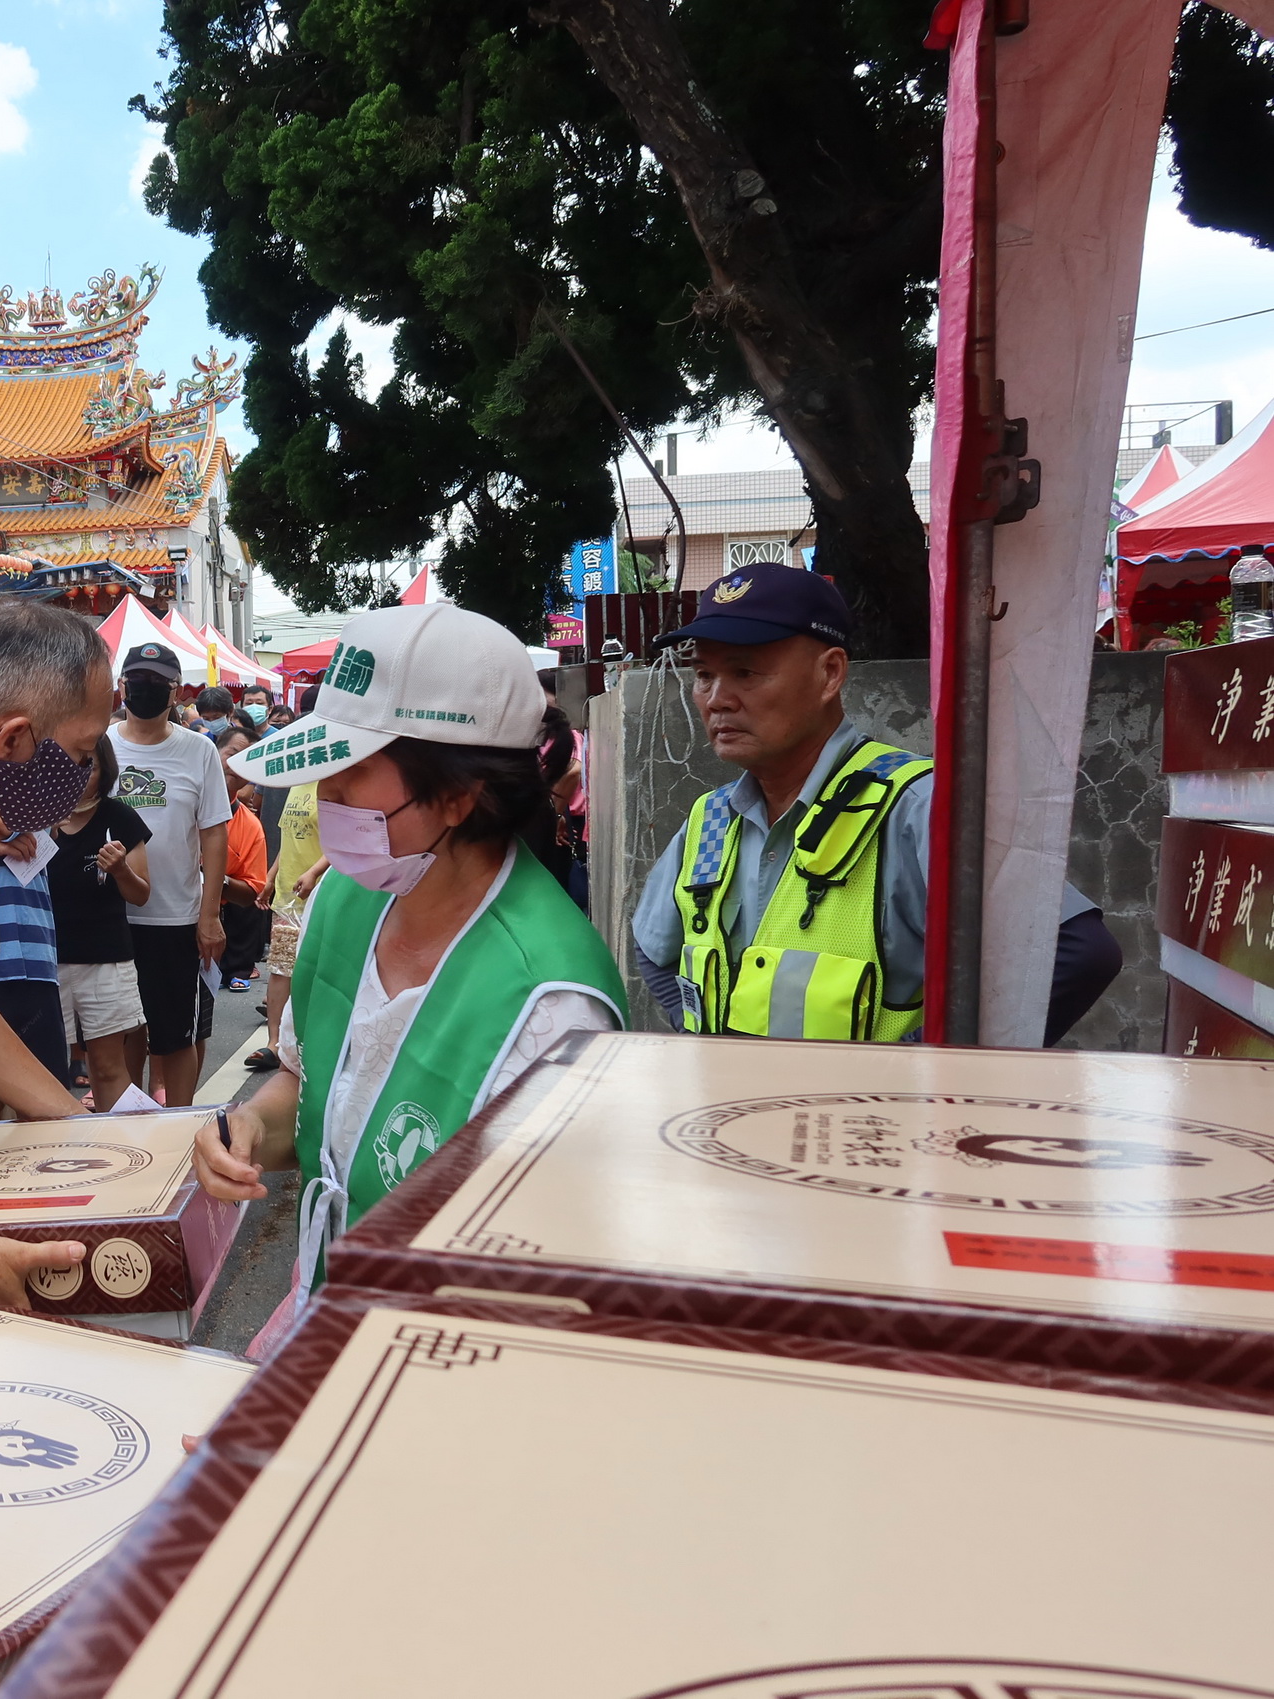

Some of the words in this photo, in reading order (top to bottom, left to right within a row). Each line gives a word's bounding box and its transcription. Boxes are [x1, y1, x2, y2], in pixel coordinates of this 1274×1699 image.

[582, 539, 603, 596] 容鍍
[394, 707, 477, 725] 彰化縣議員候選人
[245, 724, 327, 762] 團結台灣
[265, 739, 352, 777] 顧好未來
